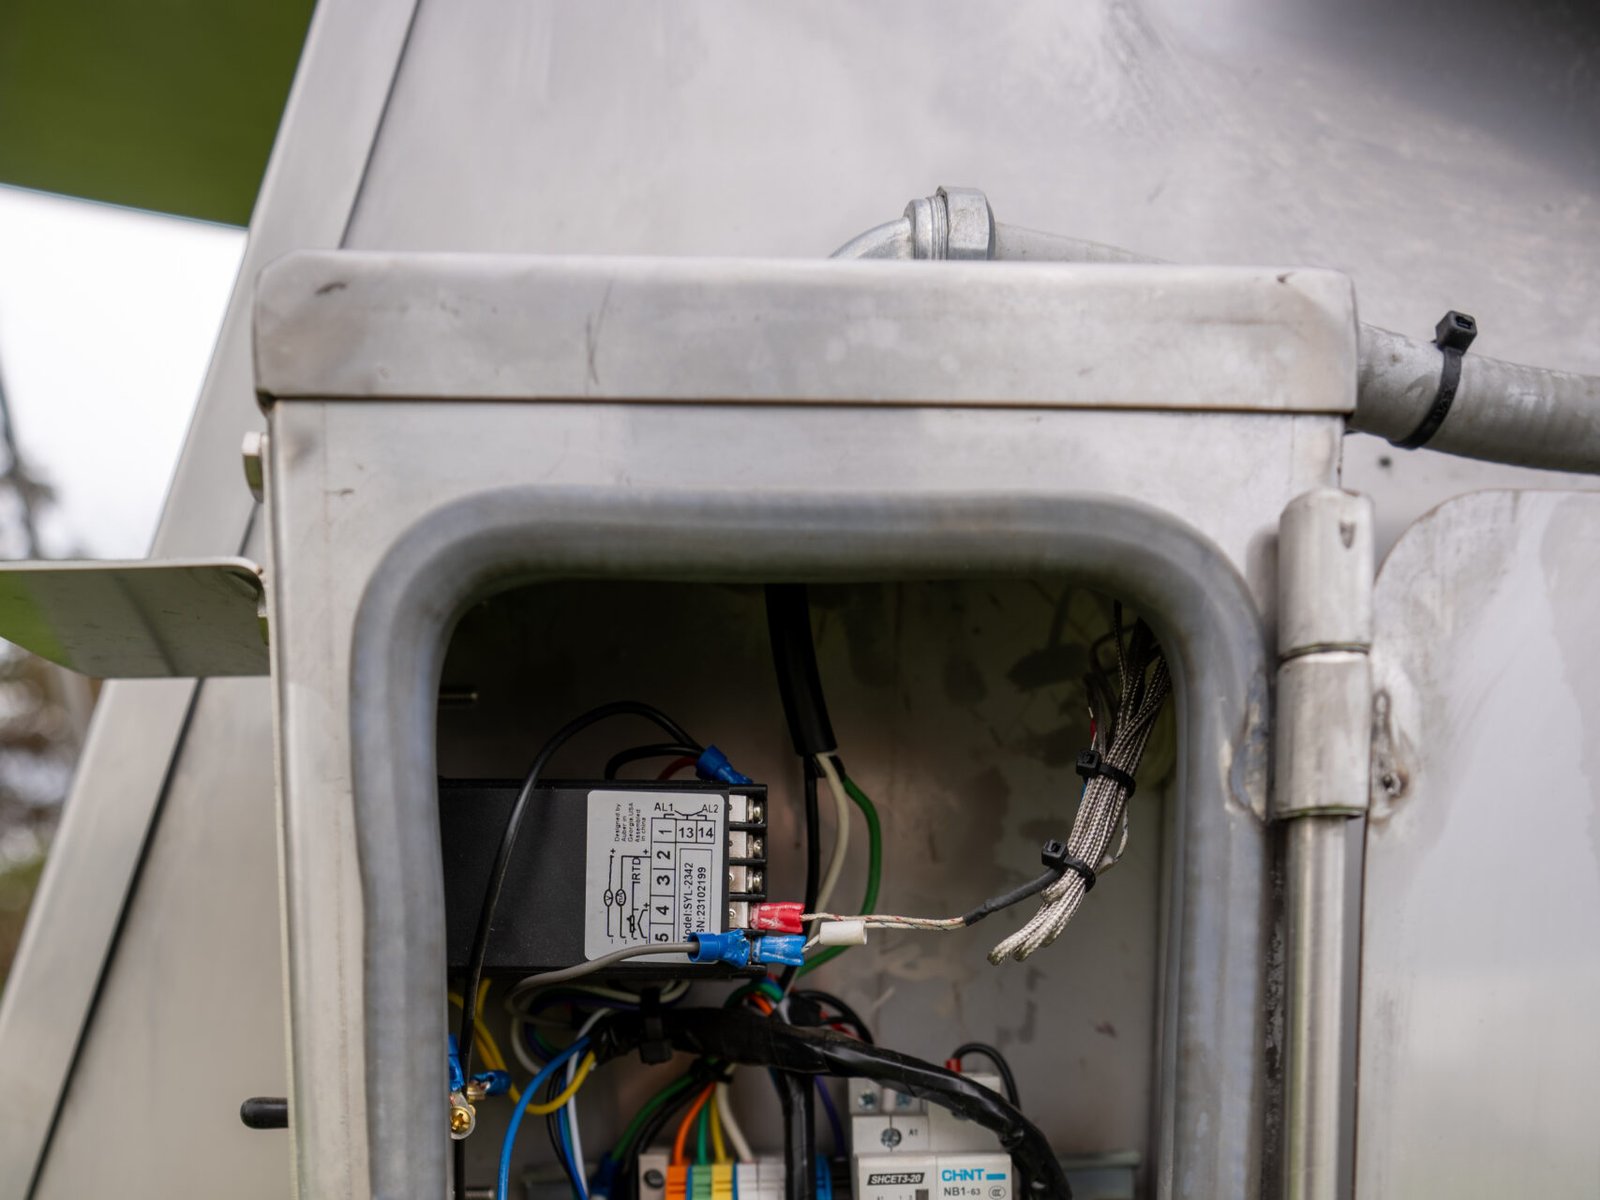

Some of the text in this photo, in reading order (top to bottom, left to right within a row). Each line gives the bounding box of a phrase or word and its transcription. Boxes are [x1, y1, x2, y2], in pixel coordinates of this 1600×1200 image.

[654, 802, 674, 812] AL1
[702, 804, 719, 814] AL2
[678, 827, 694, 839] 13
[698, 828, 714, 839] 14
[655, 850, 671, 943] 5 4 3 2
[871, 1174, 921, 1185] SHCET3-20
